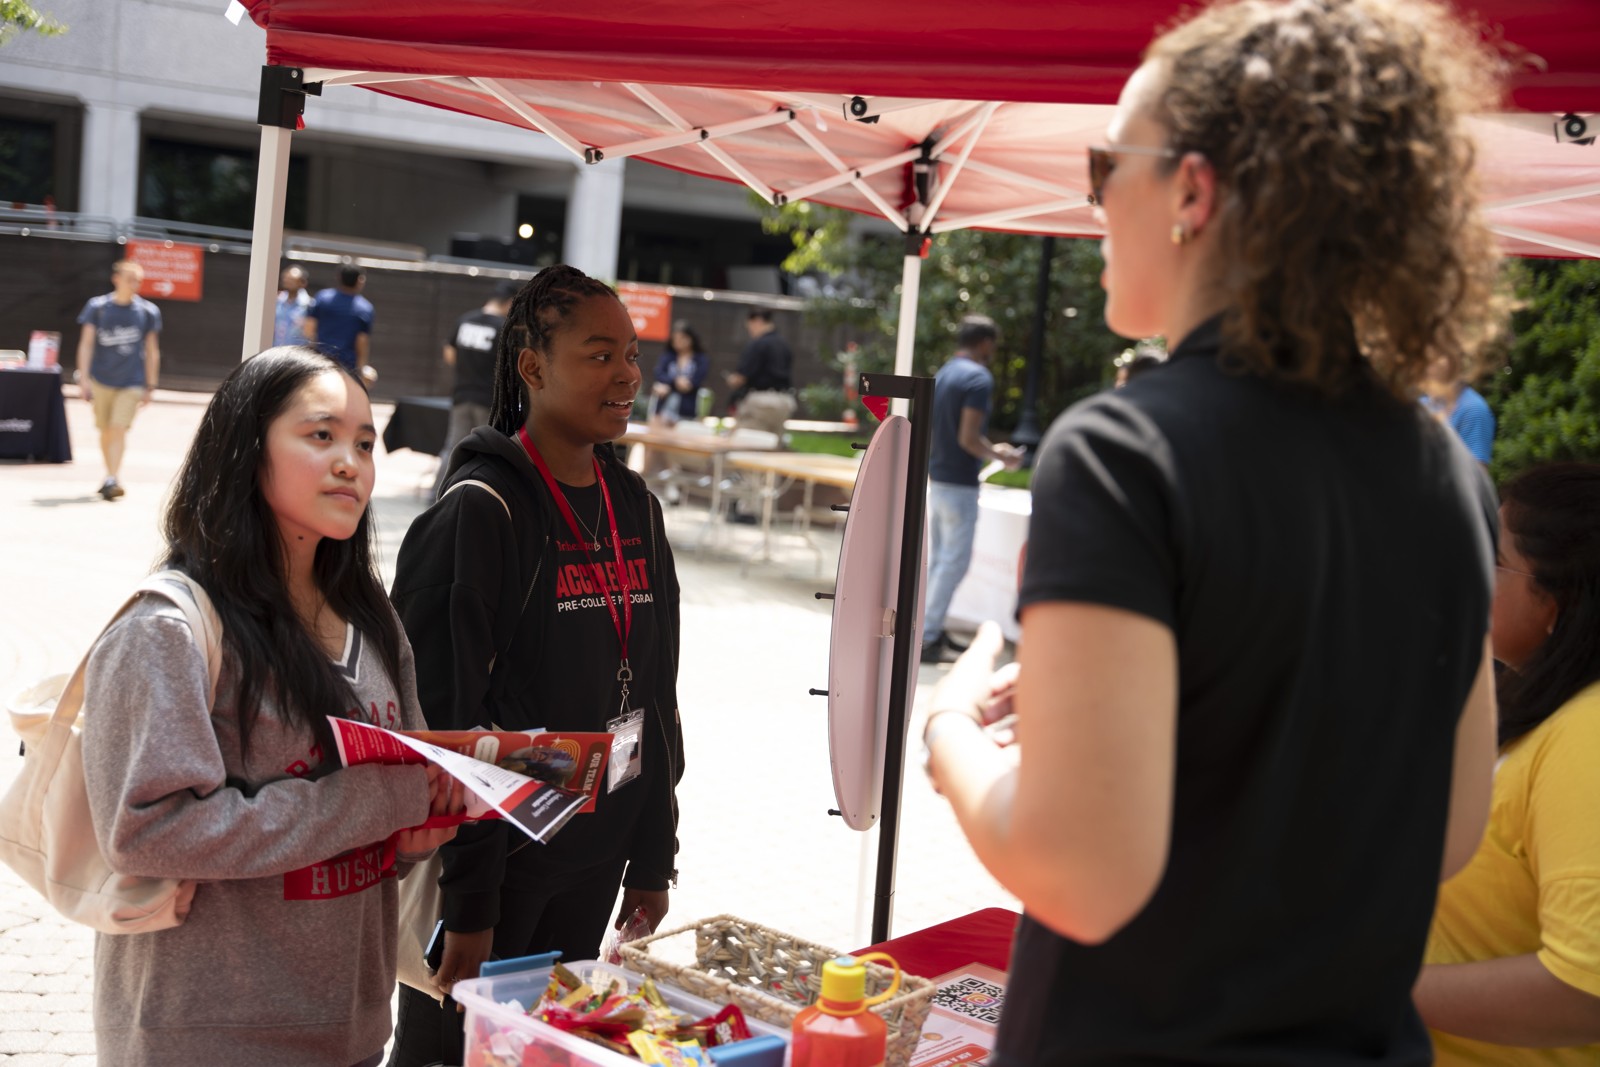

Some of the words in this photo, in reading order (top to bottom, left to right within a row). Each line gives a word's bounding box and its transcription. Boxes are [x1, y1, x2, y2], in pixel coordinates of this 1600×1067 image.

[557, 596, 616, 612] PRE-COLLEE
[589, 752, 602, 769] OUR
[582, 768, 598, 791] TEAM
